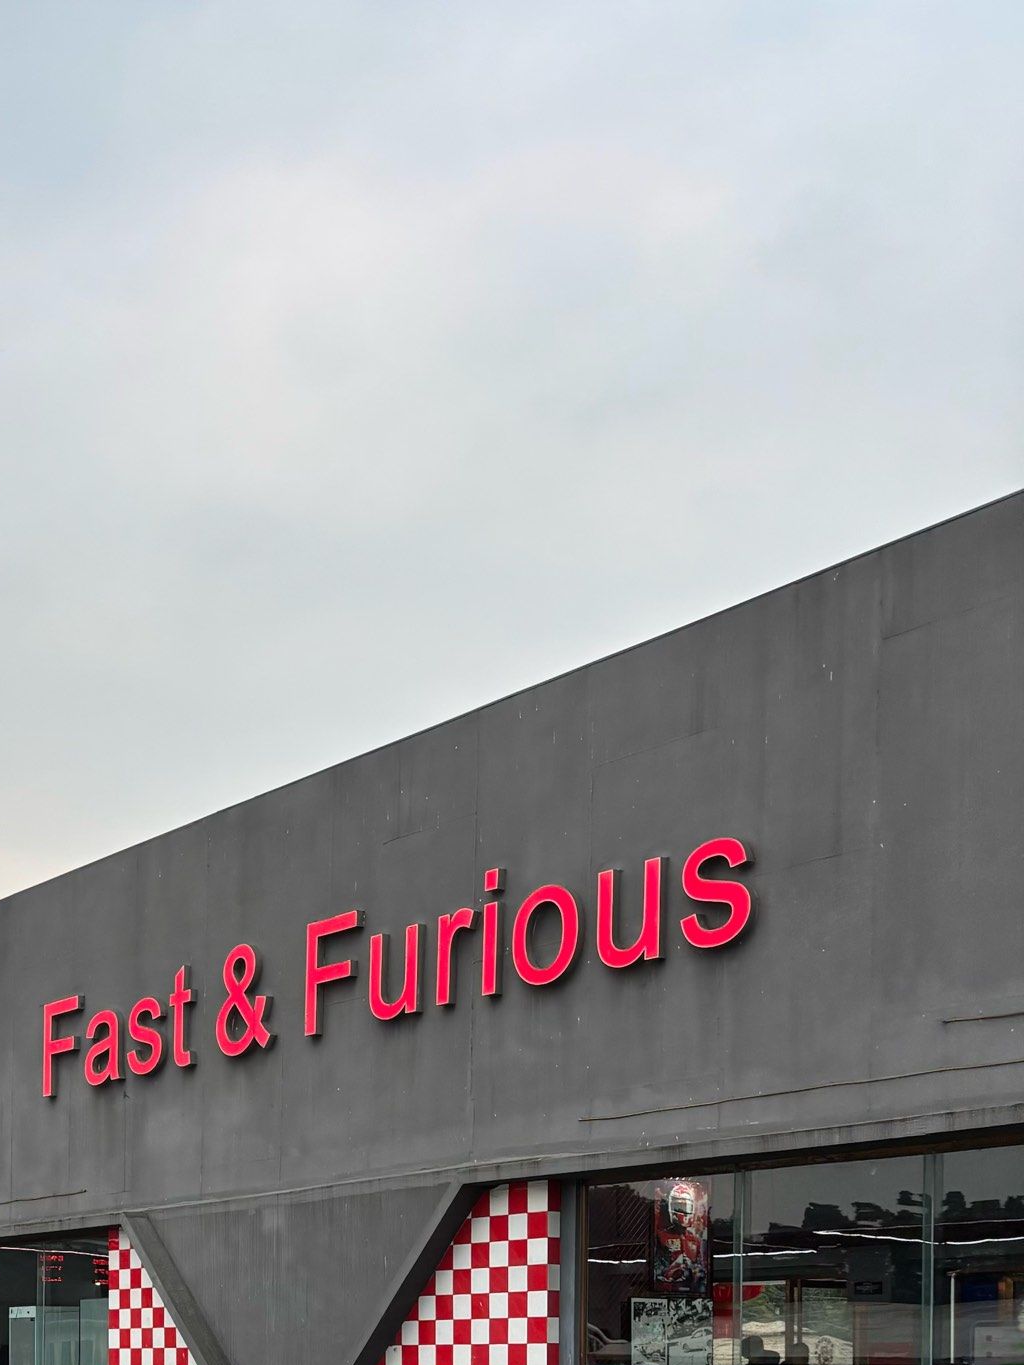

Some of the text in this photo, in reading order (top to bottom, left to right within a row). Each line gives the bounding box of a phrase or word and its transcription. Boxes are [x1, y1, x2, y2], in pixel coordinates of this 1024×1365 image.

[42, 837, 757, 1098] Fast & Furious
